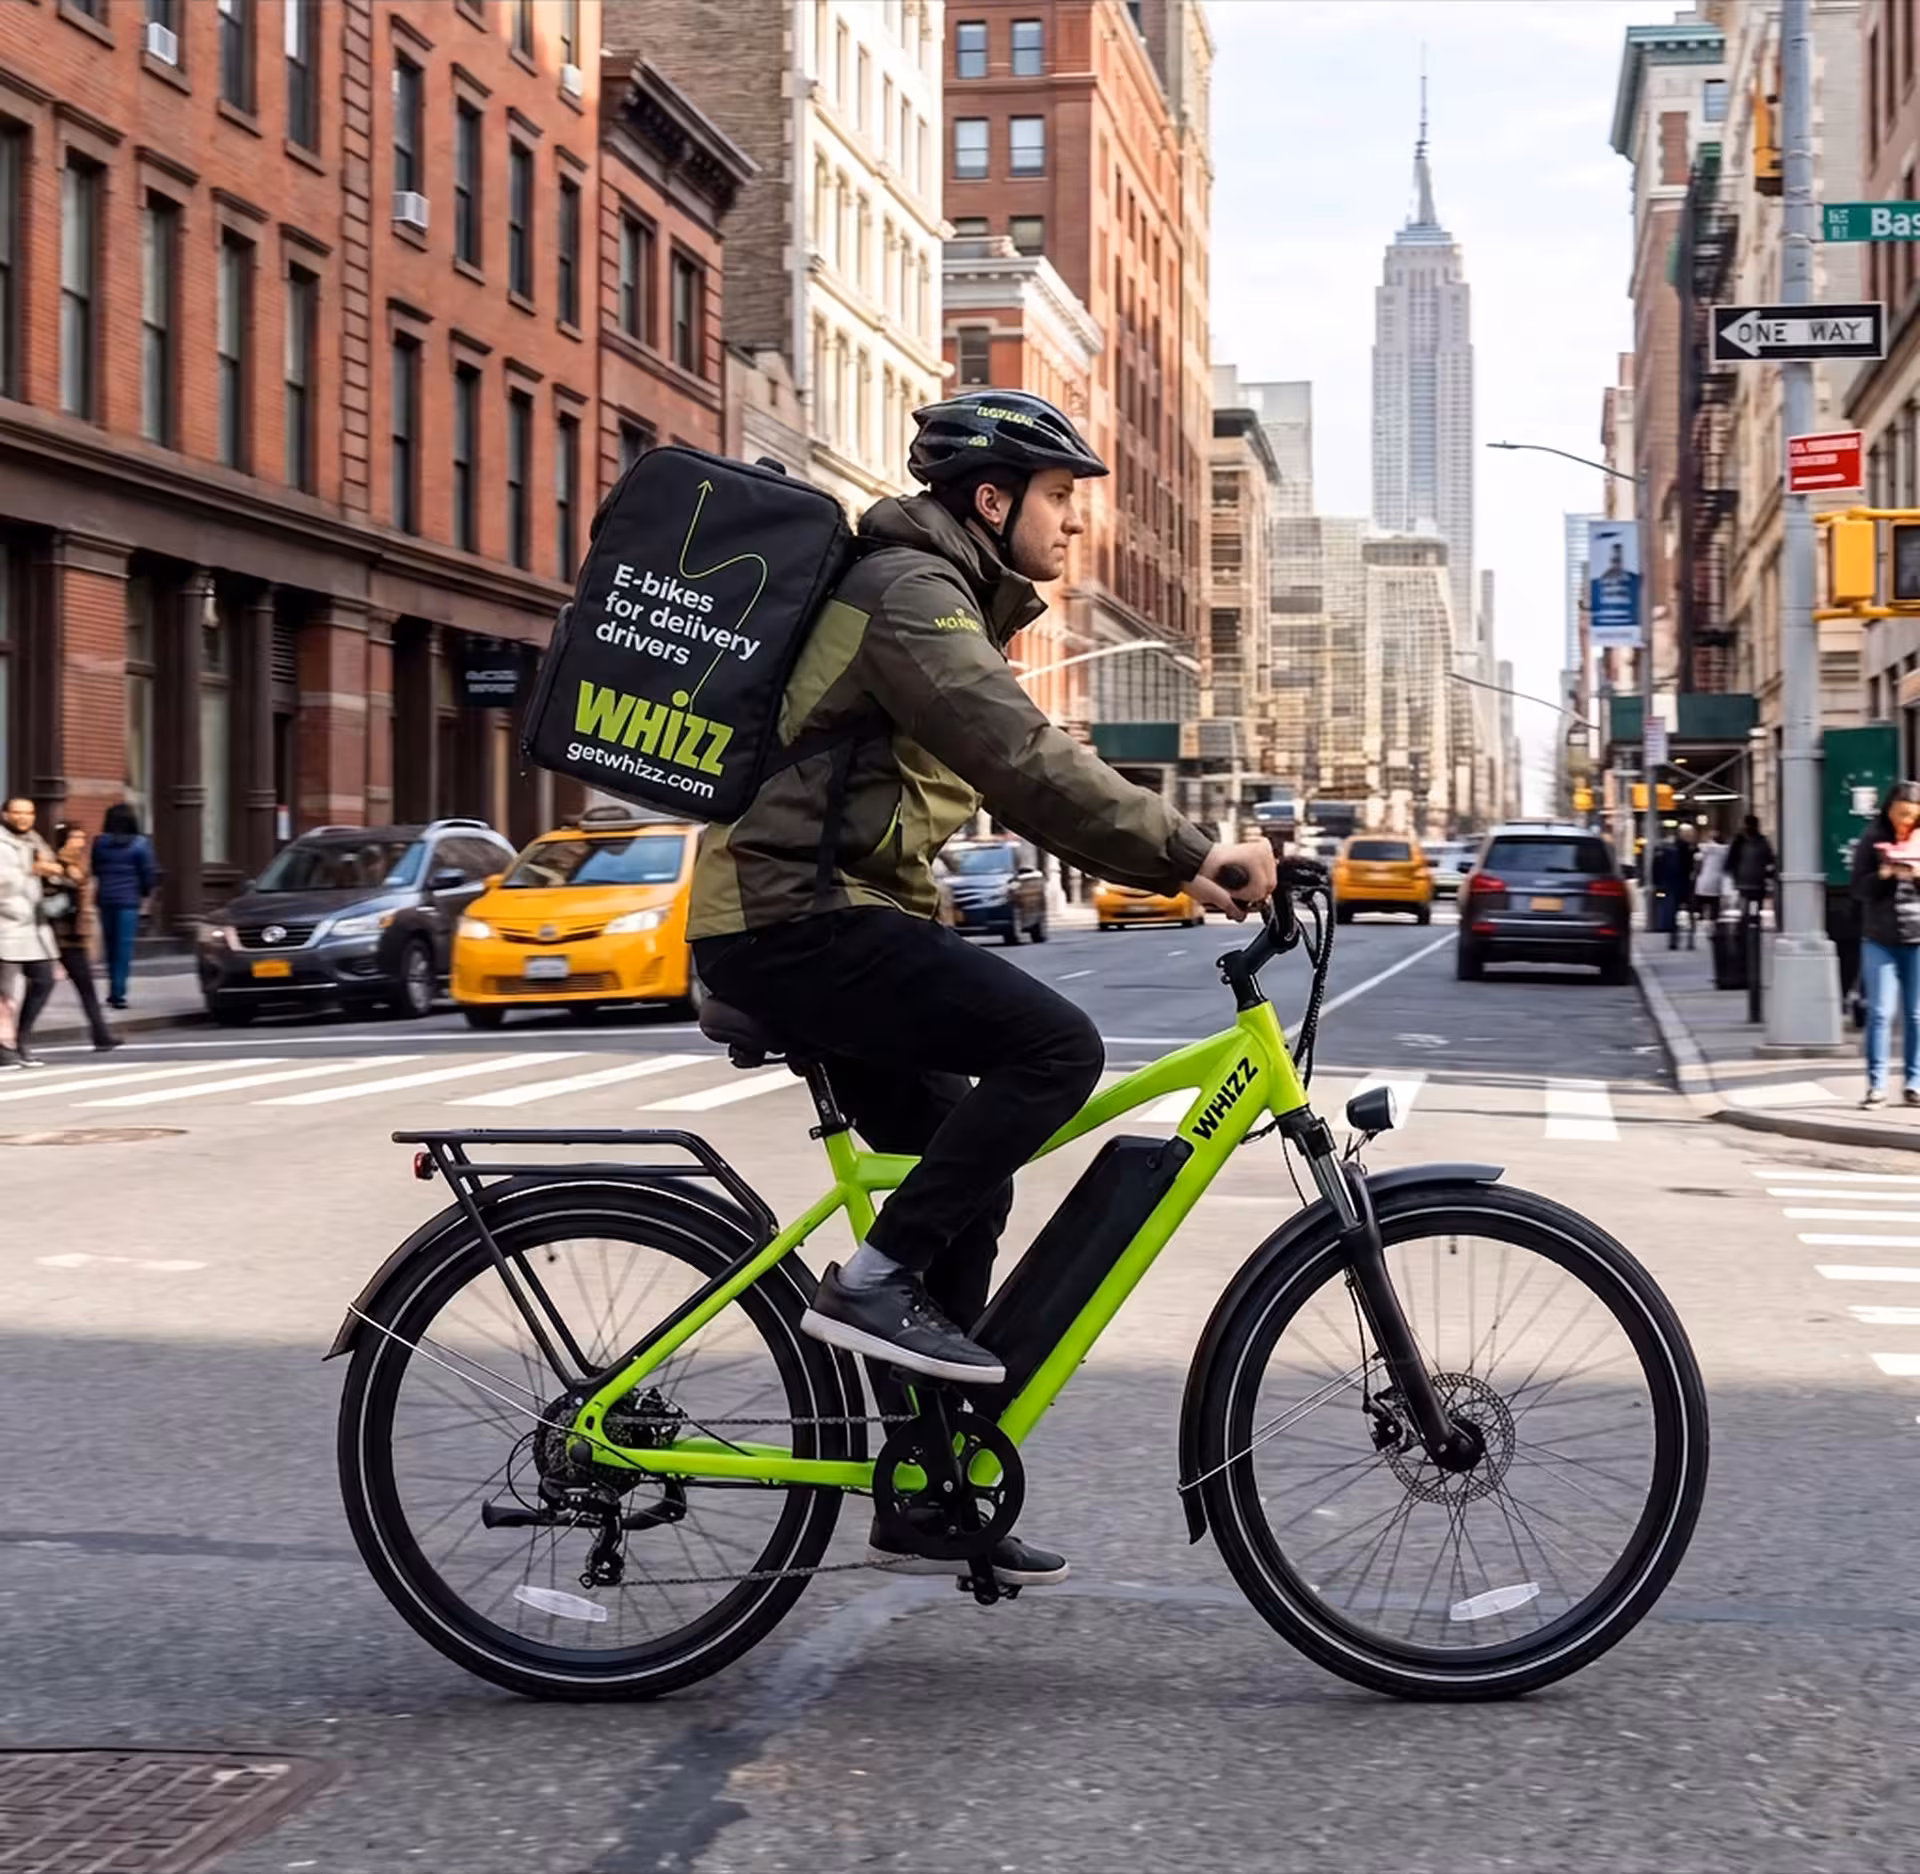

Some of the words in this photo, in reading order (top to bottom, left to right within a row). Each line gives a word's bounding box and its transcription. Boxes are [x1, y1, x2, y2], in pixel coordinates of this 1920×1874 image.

[1738, 322, 1787, 343] ONE
[605, 591, 644, 621] for
[613, 563, 714, 613] E-bikes
[595, 621, 690, 665] drivers
[566, 742, 715, 799] getwhizz.com
[1191, 1057, 1259, 1140] WHIZZ
